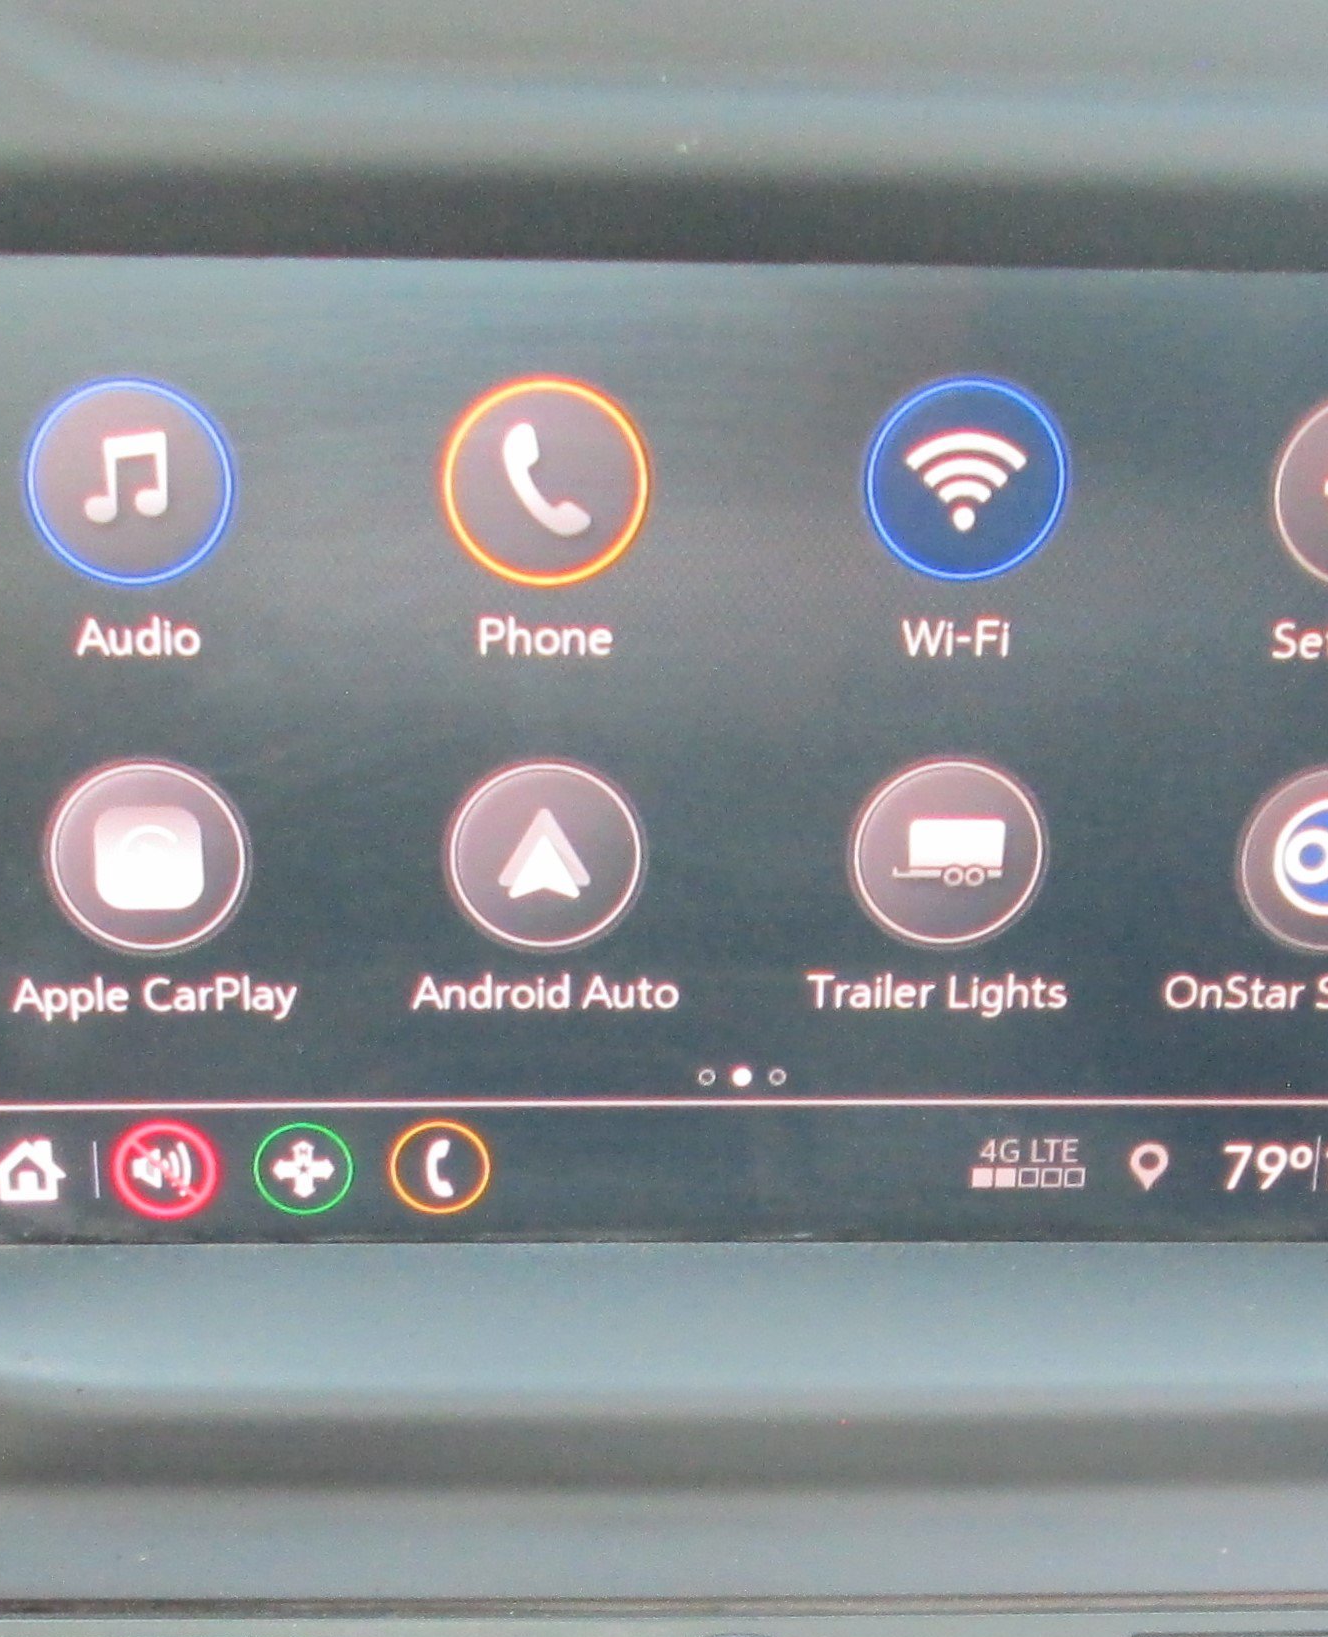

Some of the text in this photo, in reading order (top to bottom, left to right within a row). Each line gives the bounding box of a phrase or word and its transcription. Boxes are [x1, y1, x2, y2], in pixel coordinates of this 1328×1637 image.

[75, 615, 202, 657] Audio
[478, 615, 614, 657] Phone
[901, 618, 1011, 659] Wi-Fi
[12, 974, 298, 1023] Apple CarPlay
[412, 973, 680, 1011] Android Auto
[806, 972, 1069, 1019] Trailer Lights
[1163, 974, 1307, 1011] OnStar
[979, 1138, 1080, 1164] 4G LTE
